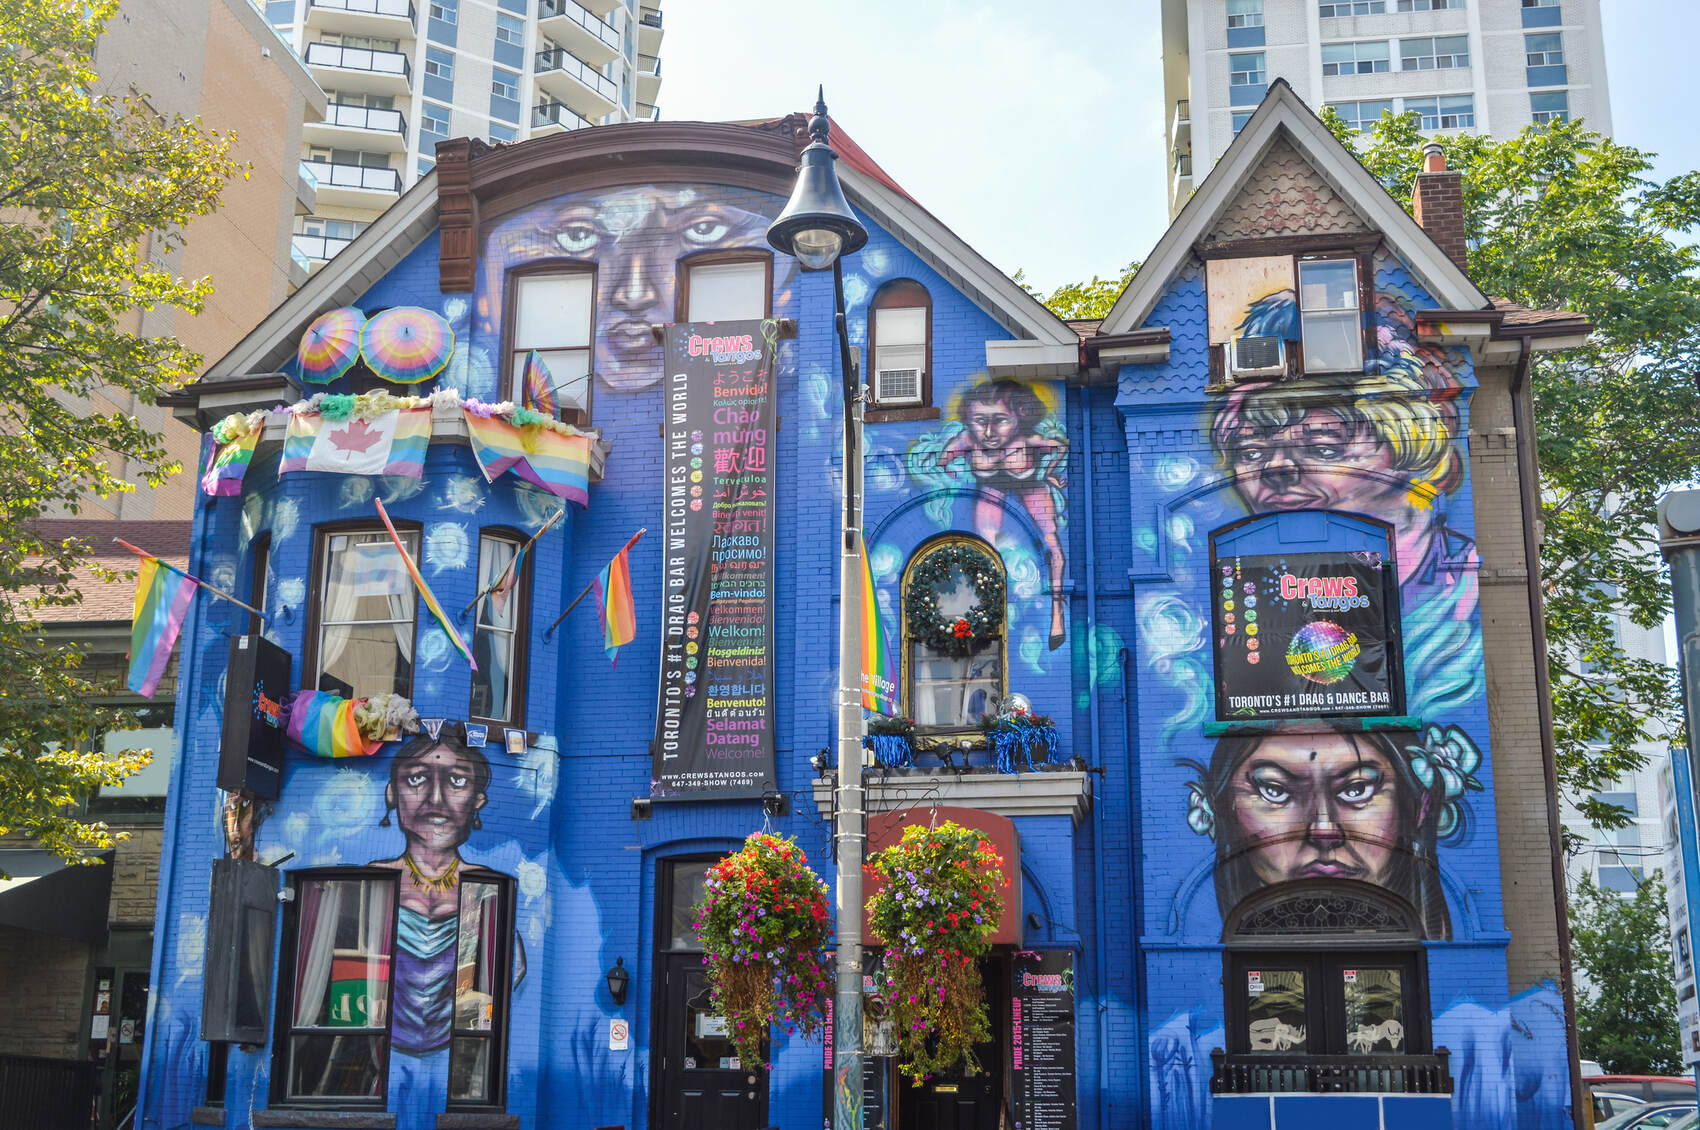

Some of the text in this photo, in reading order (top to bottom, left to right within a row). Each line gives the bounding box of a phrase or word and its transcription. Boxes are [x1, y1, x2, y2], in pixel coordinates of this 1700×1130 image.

[689, 335, 752, 356] Crews
[711, 349, 762, 364] Tangos
[714, 382, 768, 398] Benvido!
[714, 406, 760, 424] Chào
[714, 426, 766, 446] mừng
[714, 446, 767, 474] 歡迎
[712, 534, 760, 548] Ласкаво
[712, 546, 766, 563] просимо!
[664, 374, 688, 760] TORONTO'S #1 DRAG BAR WELCOMES THE WORLD
[710, 588, 766, 600] Bem-vindo!
[1281, 574, 1358, 600] Crews
[1307, 594, 1370, 612] Tangos
[709, 614, 766, 624] Bienvenido!
[708, 624, 766, 638] Welkom!
[708, 637, 766, 647] Bienvenue!
[1285, 650, 1320, 666] TORONTO'S
[1330, 639, 1350, 656] DRAG
[707, 656, 766, 668] Bienvenida!
[1290, 662, 1326, 676] WELCOMES
[1326, 656, 1342, 670] THE
[708, 683, 766, 697] 환영합니다
[706, 696, 766, 708] Benvenuto!
[1229, 691, 1390, 708] TORONTO'S #1 DRAG & DANCE BAR
[707, 718, 766, 732] Selamat
[706, 732, 760, 747] Datang
[706, 747, 766, 760] Welcome!
[672, 778, 754, 788] 647-349-SHOW (7469)
[1023, 972, 1062, 986] Crews
[824, 1025, 833, 1045] 2015
[1013, 1025, 1022, 1046] 2015
[824, 1046, 833, 1070] PRIDE
[1014, 1046, 1022, 1070] PRIDE
